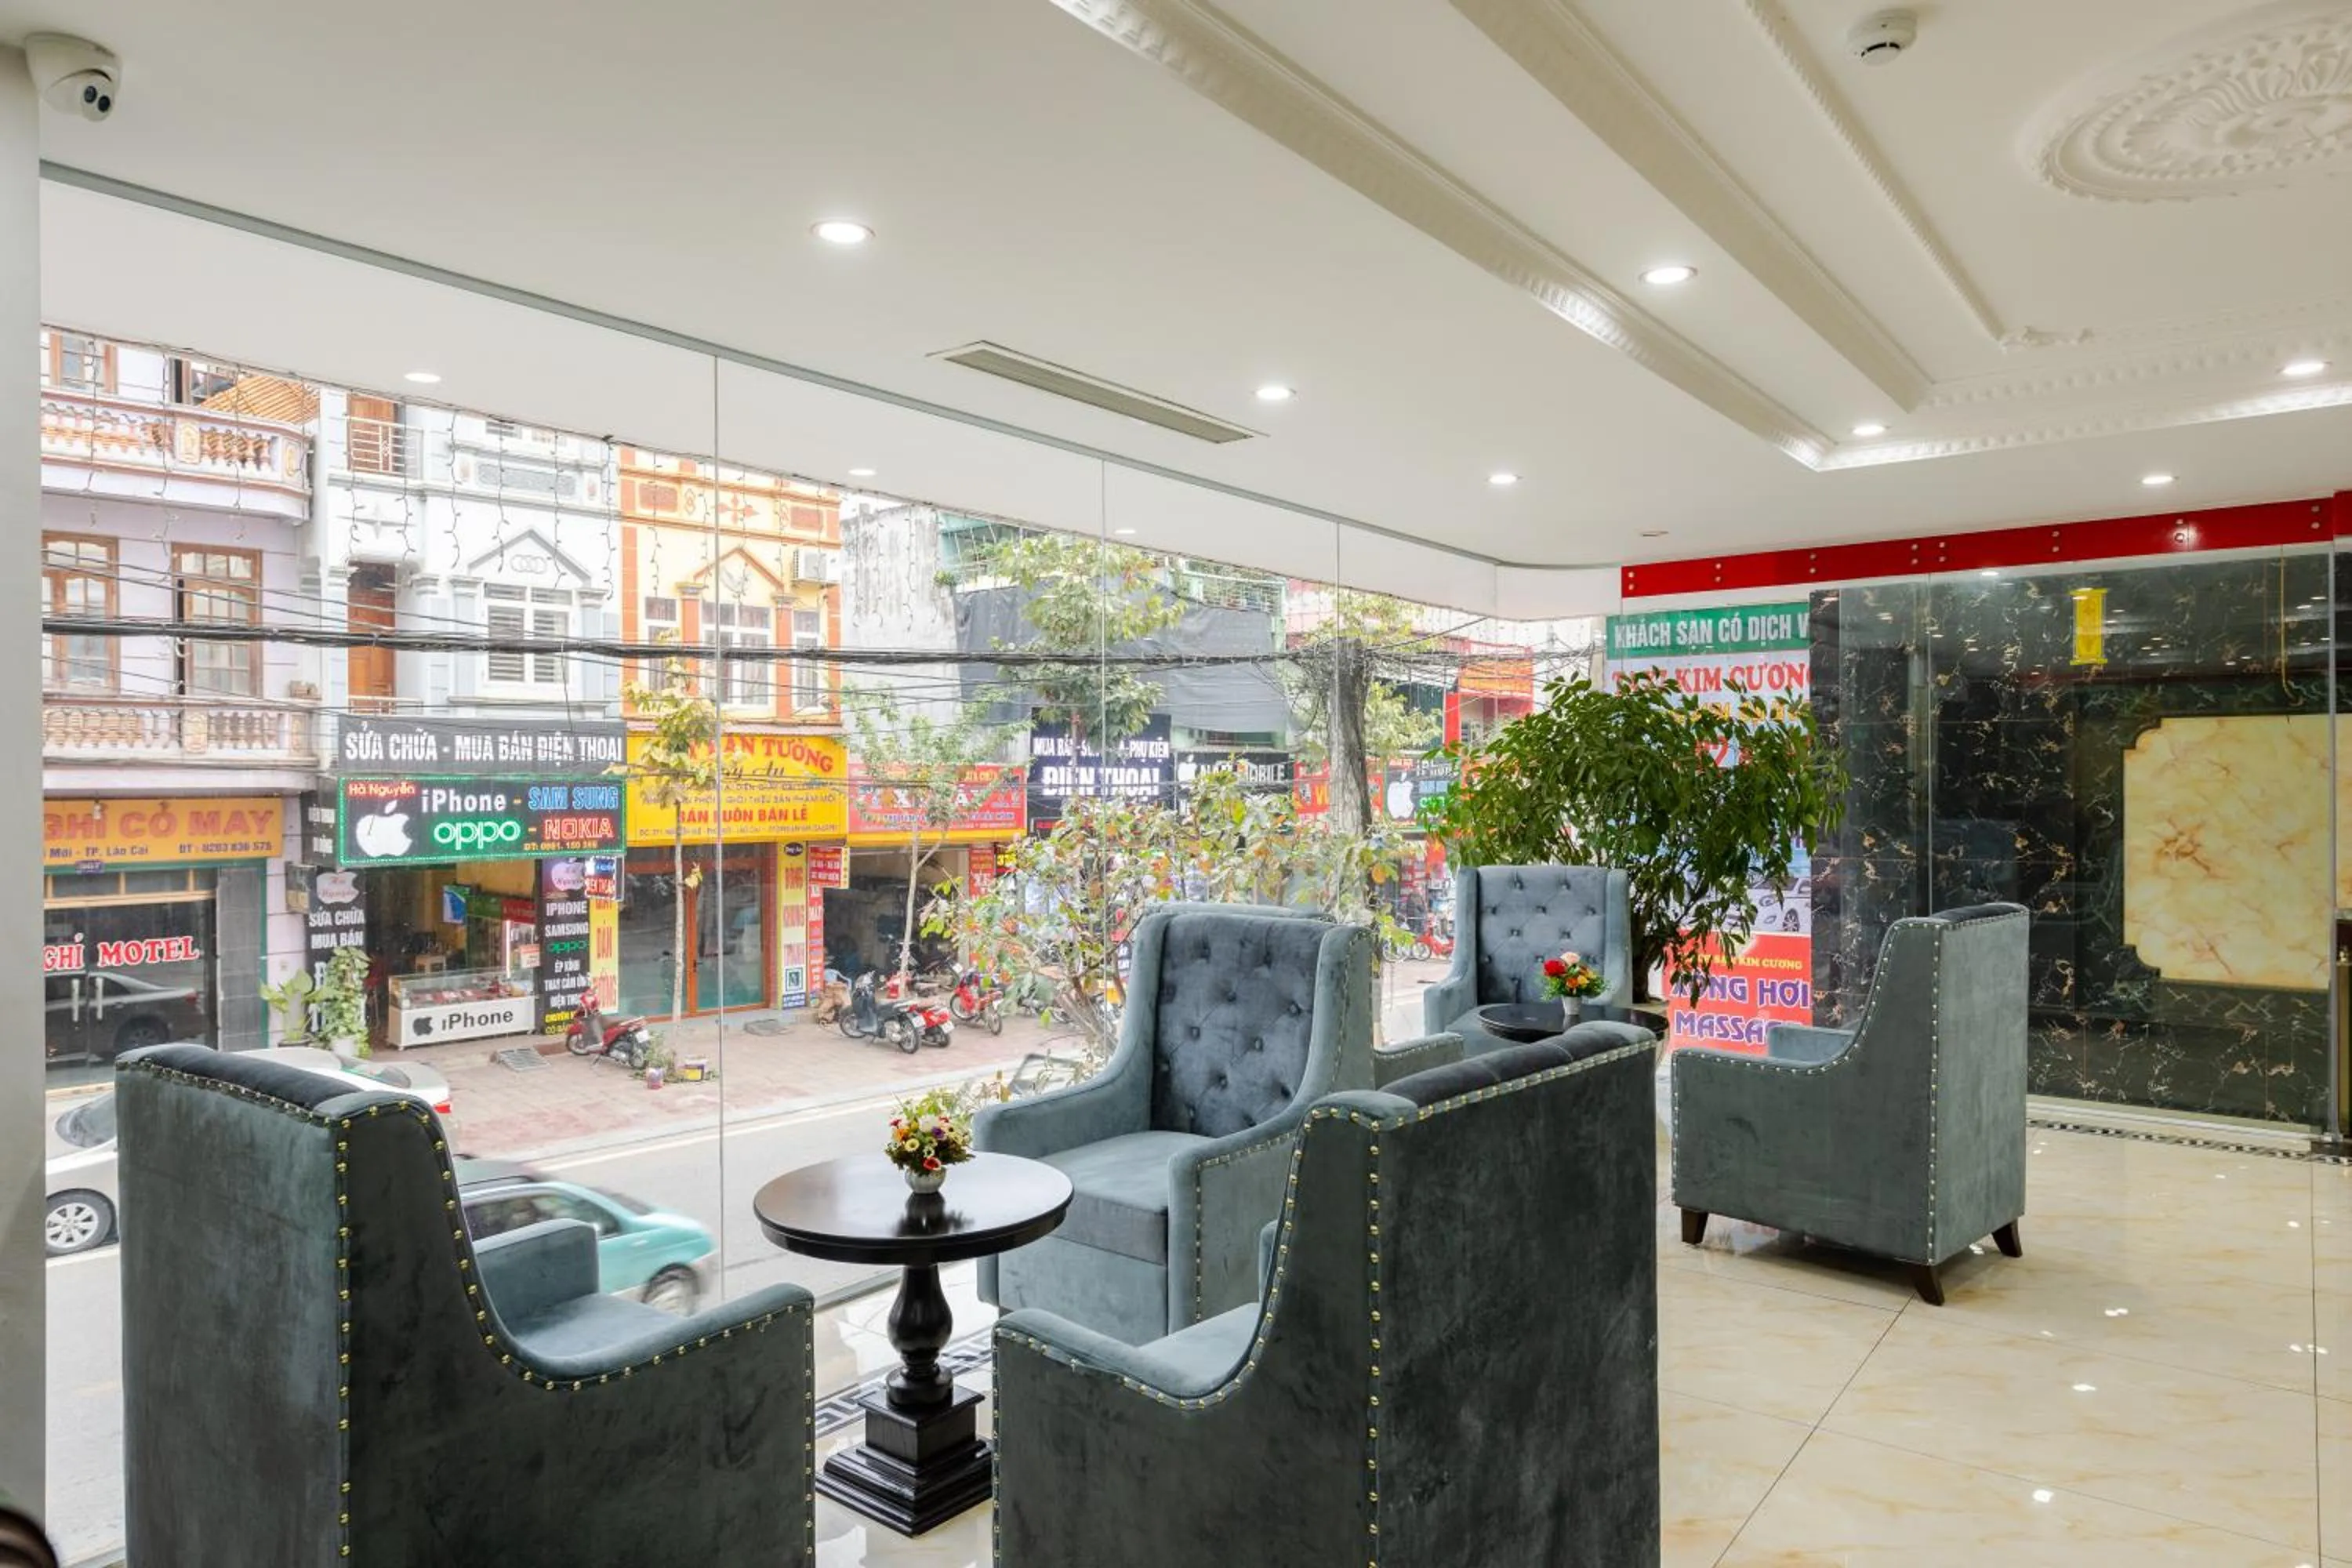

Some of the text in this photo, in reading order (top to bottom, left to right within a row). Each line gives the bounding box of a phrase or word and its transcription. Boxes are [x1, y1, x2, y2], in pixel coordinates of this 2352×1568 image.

[1614, 612, 1810, 649] KHÁCH SẠN CÓ DỊCH V
[1675, 666, 1722, 693] KIM
[1730, 661, 1810, 691] CƯƠN
[345, 720, 384, 760] SỬA
[389, 728, 438, 760] CHỮA
[454, 735, 494, 761] MUA
[498, 730, 533, 761] BÁN
[1033, 737, 1055, 757] MUA
[421, 788, 506, 813] iPhone
[119, 800, 177, 839] CỎ
[188, 809, 274, 837] MAY
[758, 805, 788, 822] BÁN
[543, 816, 615, 840] NOKIA
[546, 901, 588, 916] IPHONE
[311, 933, 337, 949] MUA
[545, 922, 590, 938] SAMSUNG
[98, 935, 201, 968] MOTEL
[1757, 976, 1811, 1009] HƠI
[441, 1010, 514, 1031] iPhone
[1675, 1009, 1784, 1045] MASSA
